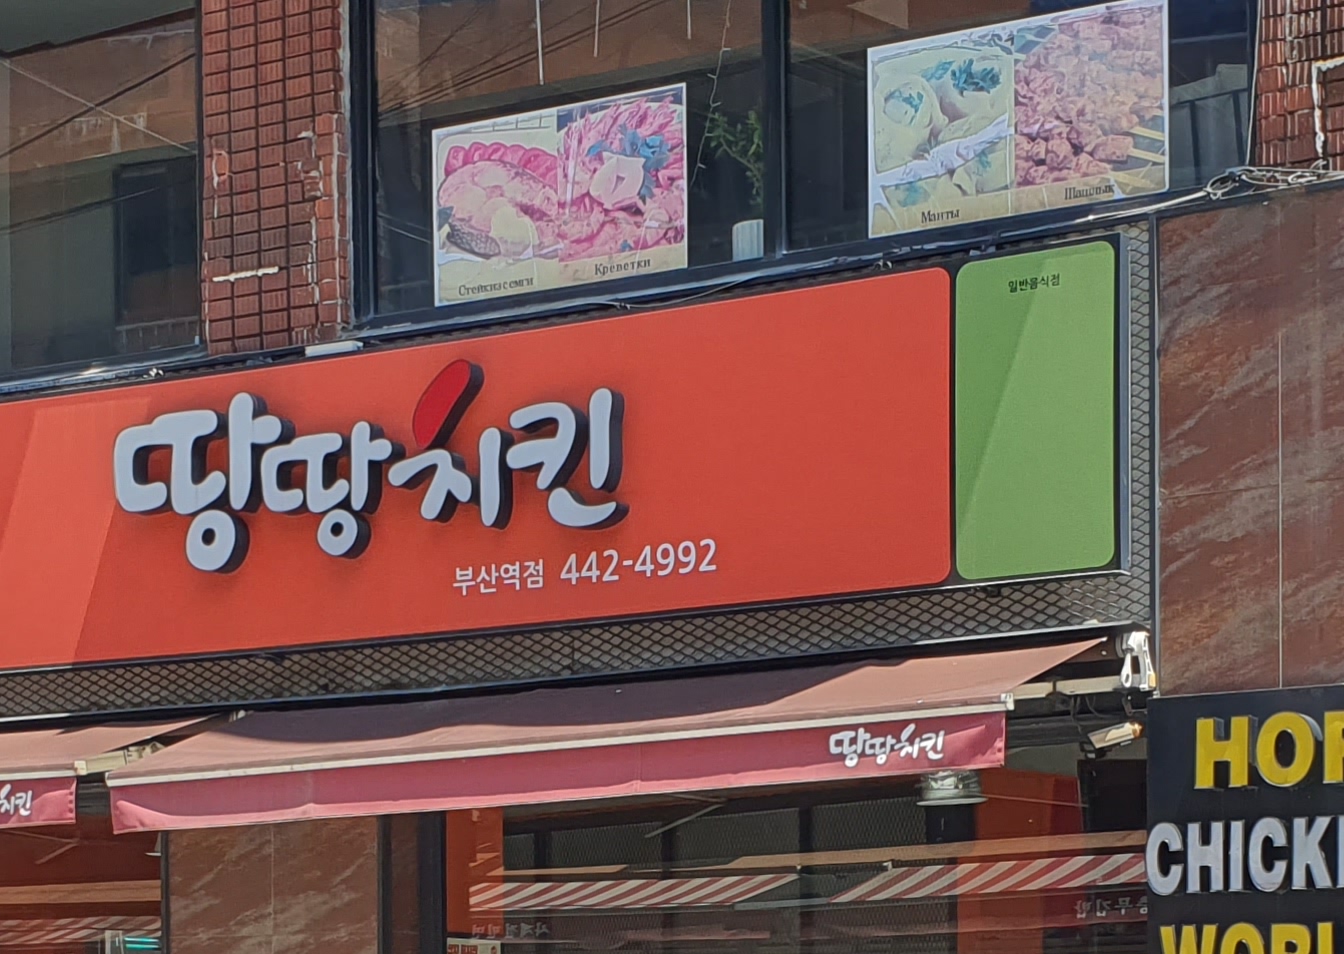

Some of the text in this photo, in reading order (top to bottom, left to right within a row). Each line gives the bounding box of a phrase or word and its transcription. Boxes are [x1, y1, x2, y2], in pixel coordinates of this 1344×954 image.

[594, 259, 651, 276] Креветки
[113, 360, 622, 572] 땅땅치킨
[452, 538, 717, 596] 부산역점 442-4992
[829, 723, 945, 767] 땅땅치킨
